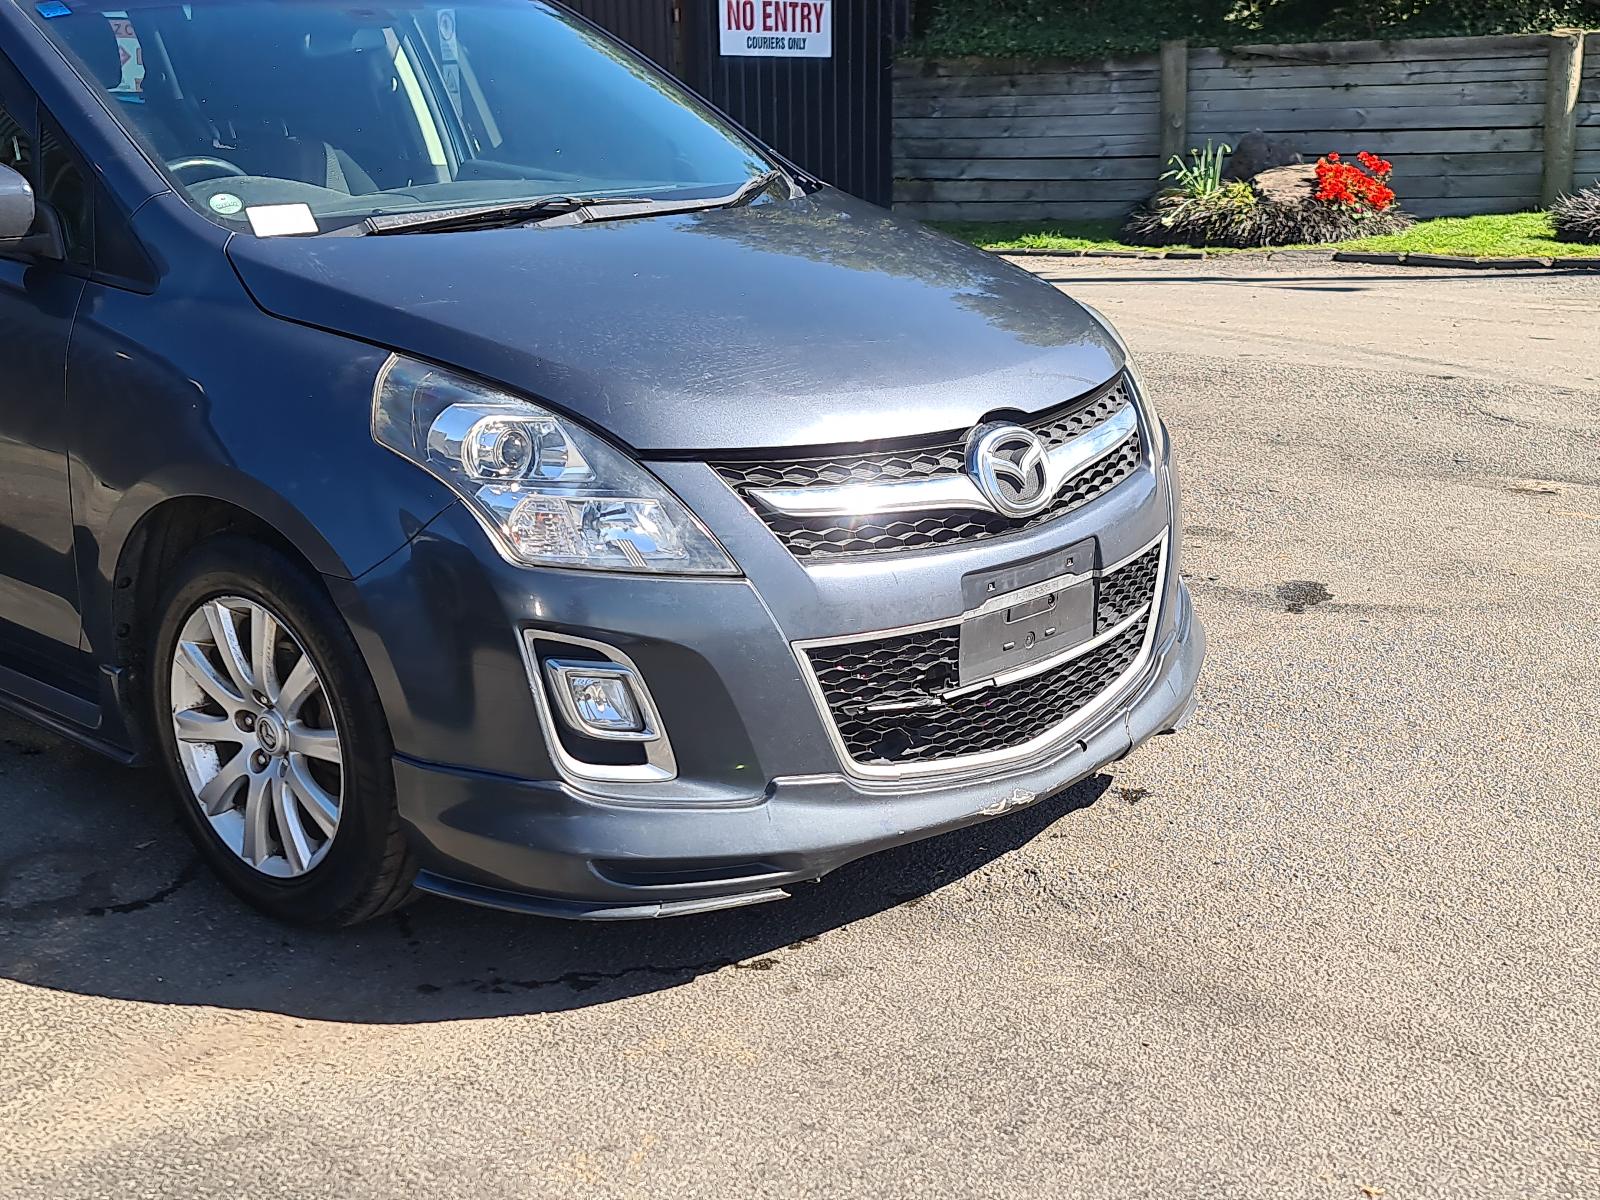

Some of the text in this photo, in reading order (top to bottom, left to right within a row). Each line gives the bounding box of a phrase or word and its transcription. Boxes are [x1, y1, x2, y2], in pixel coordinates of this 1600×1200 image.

[727, 0, 824, 33] NO ENTRY
[746, 36, 807, 50] COURIERS ONLY
